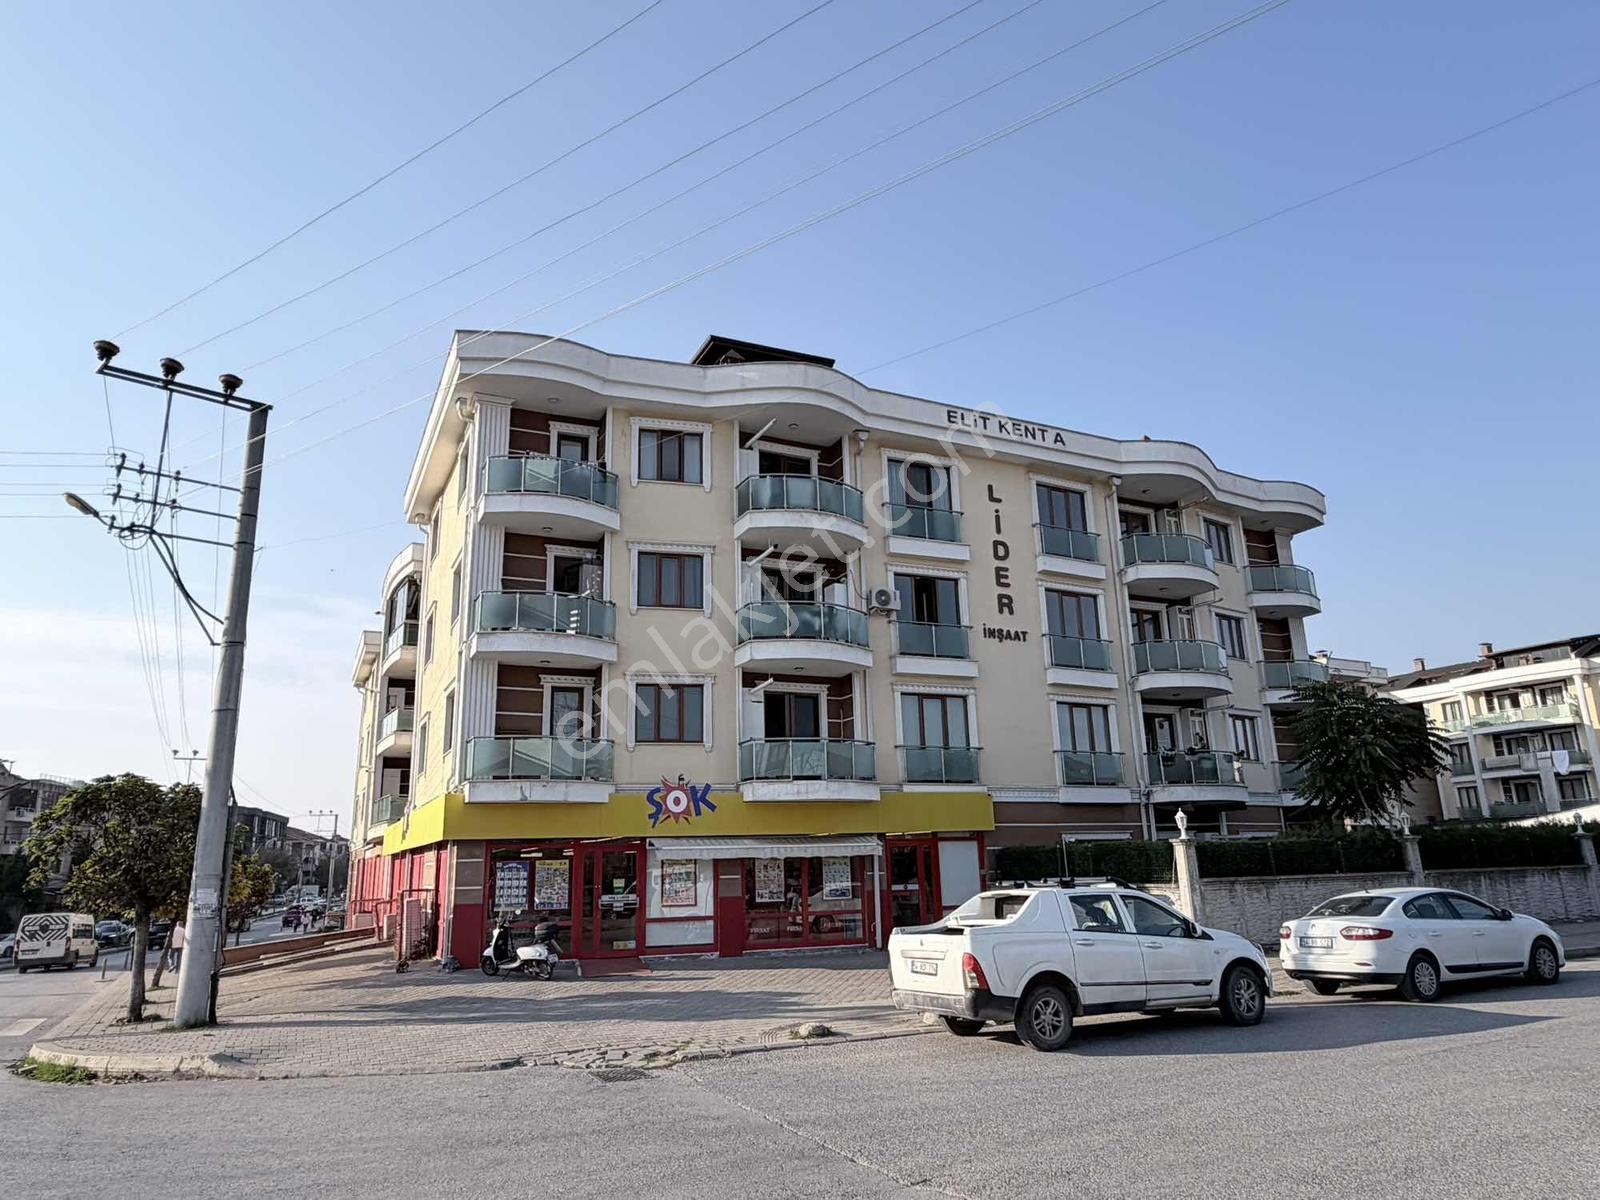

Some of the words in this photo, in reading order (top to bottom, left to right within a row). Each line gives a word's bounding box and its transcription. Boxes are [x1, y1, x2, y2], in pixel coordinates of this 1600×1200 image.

[998, 419, 1048, 443] KENT
[1053, 432, 1066, 447] A
[983, 623, 1029, 643] İNŞAAT
[646, 778, 717, 829] ŞOK
